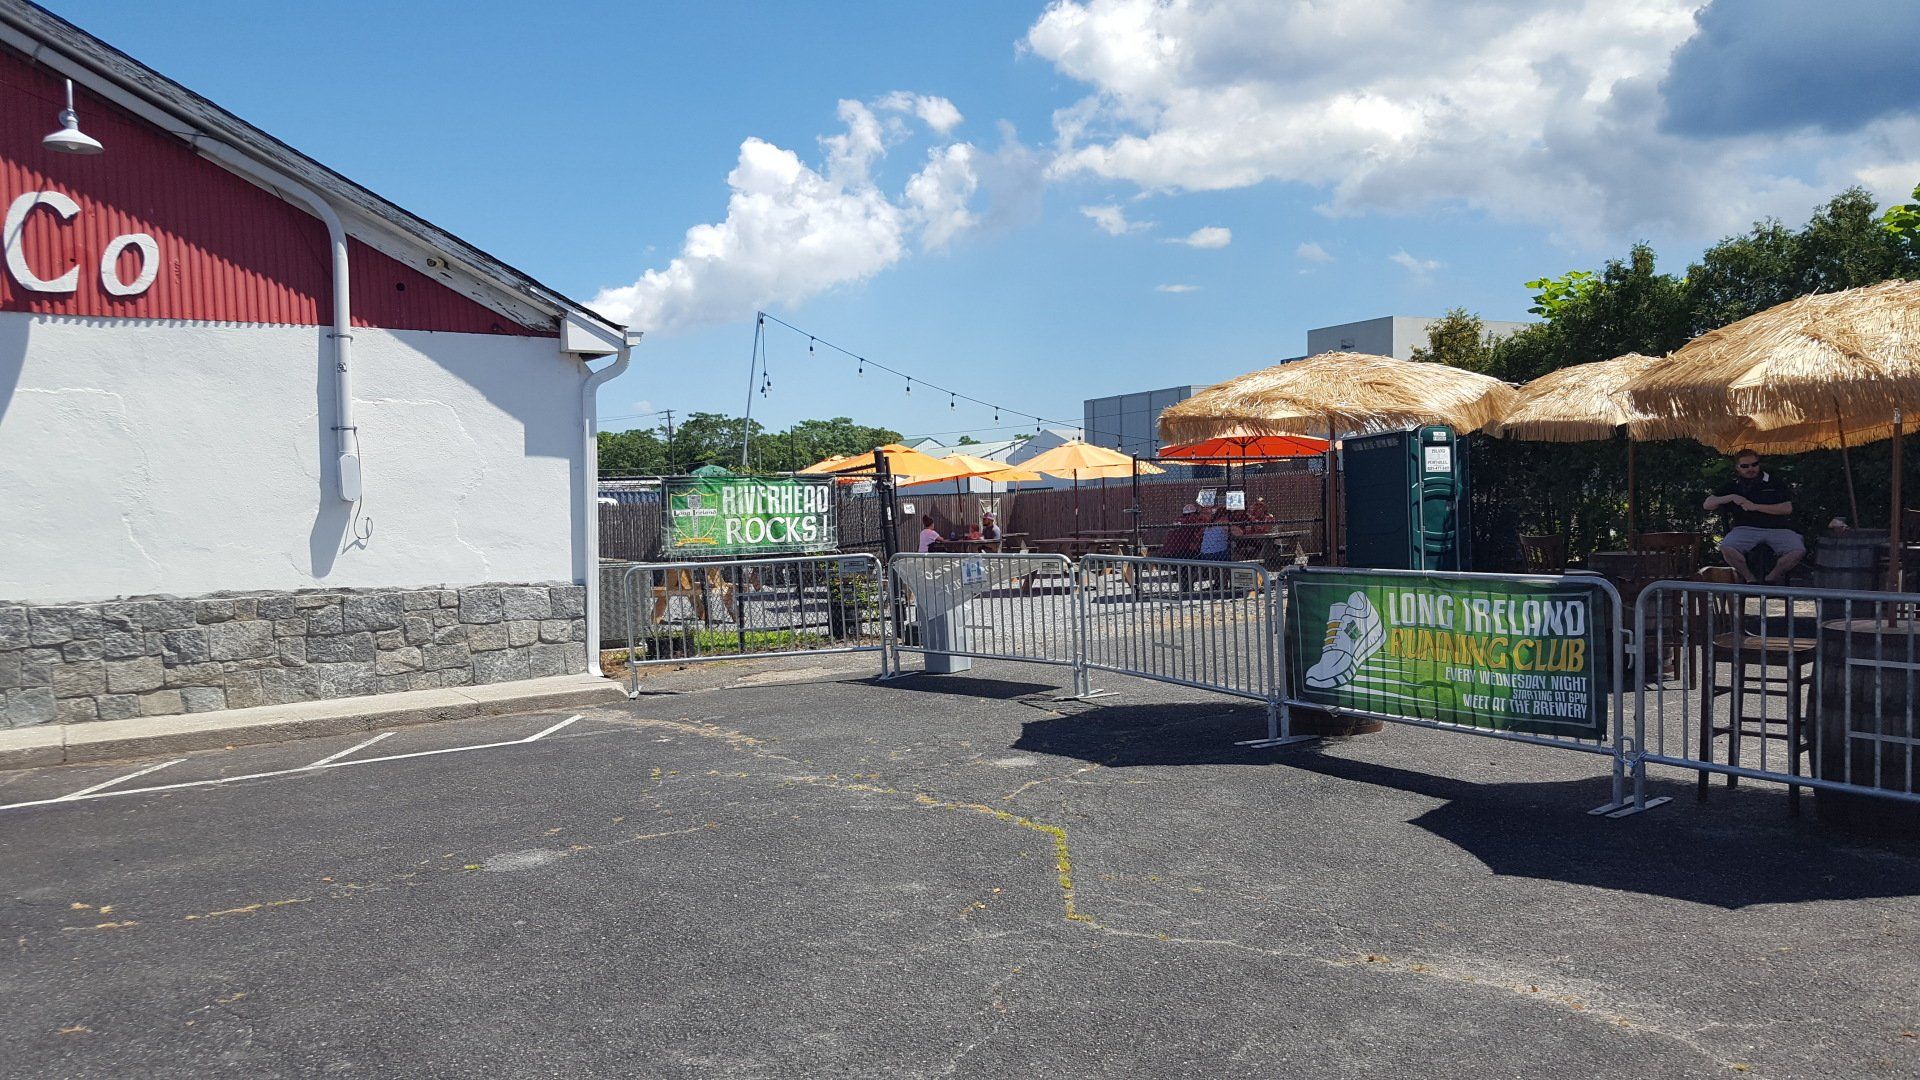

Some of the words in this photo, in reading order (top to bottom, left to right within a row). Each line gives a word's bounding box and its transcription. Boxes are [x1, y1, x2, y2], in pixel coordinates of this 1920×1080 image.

[3, 190, 160, 296] Co
[674, 509, 691, 517] Long
[723, 486, 829, 514] RIVERHEAD
[1389, 592, 1453, 629] LONG
[1463, 598, 1585, 636] IRELAND
[1390, 628, 1506, 668] RUNNING
[1512, 638, 1585, 673] CLUB
[1445, 667, 1477, 684] EVERY
[1480, 670, 1546, 689] WEDNESDAY
[1551, 675, 1587, 692] NIGHT
[1463, 694, 1489, 710] MEET
[1492, 696, 1506, 711] AT
[1509, 698, 1530, 715] THE
[1532, 701, 1587, 720] BREWERY
[1512, 689, 1552, 703] STARTING
[1555, 691, 1567, 703] AT
[1569, 692, 1587, 704] 6PM
